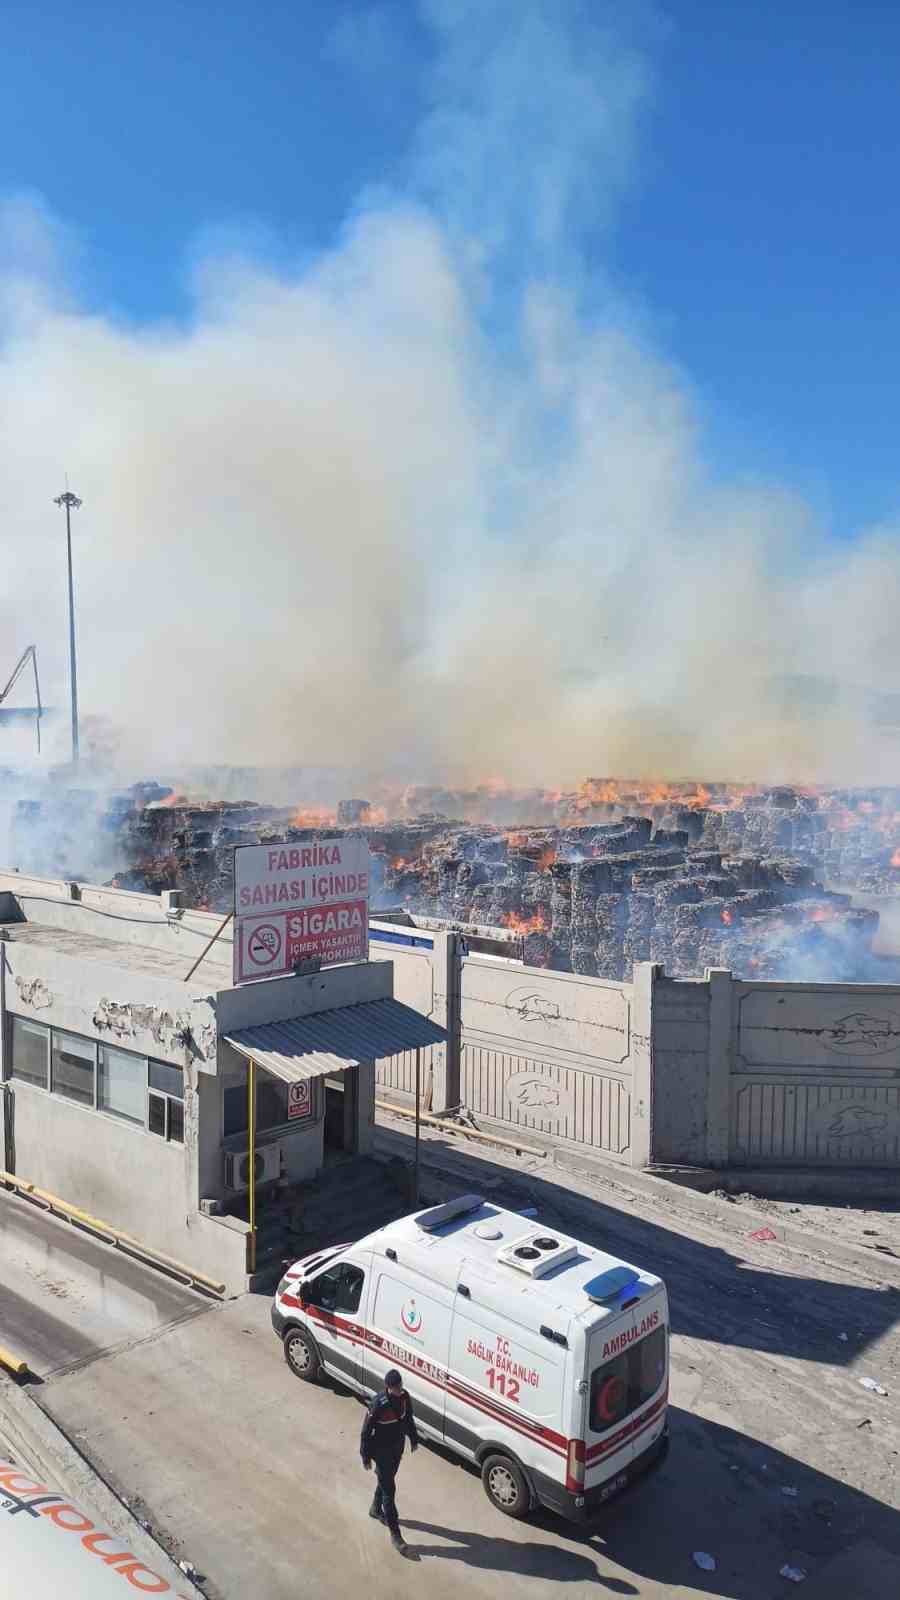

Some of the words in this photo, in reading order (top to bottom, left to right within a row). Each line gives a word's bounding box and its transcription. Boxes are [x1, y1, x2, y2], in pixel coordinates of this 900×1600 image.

[268, 843, 342, 871] FABRİKA
[240, 878, 306, 907] SAHASI
[311, 872, 368, 902] İÇİNDE
[289, 908, 363, 939] SİGARA
[496, 1335, 512, 1357] T.C.
[602, 1310, 659, 1359] AMBULANS
[467, 1339, 495, 1363] SAĞLIK
[495, 1353, 539, 1388] BAKANLIĞI
[486, 1368, 521, 1403] 112
